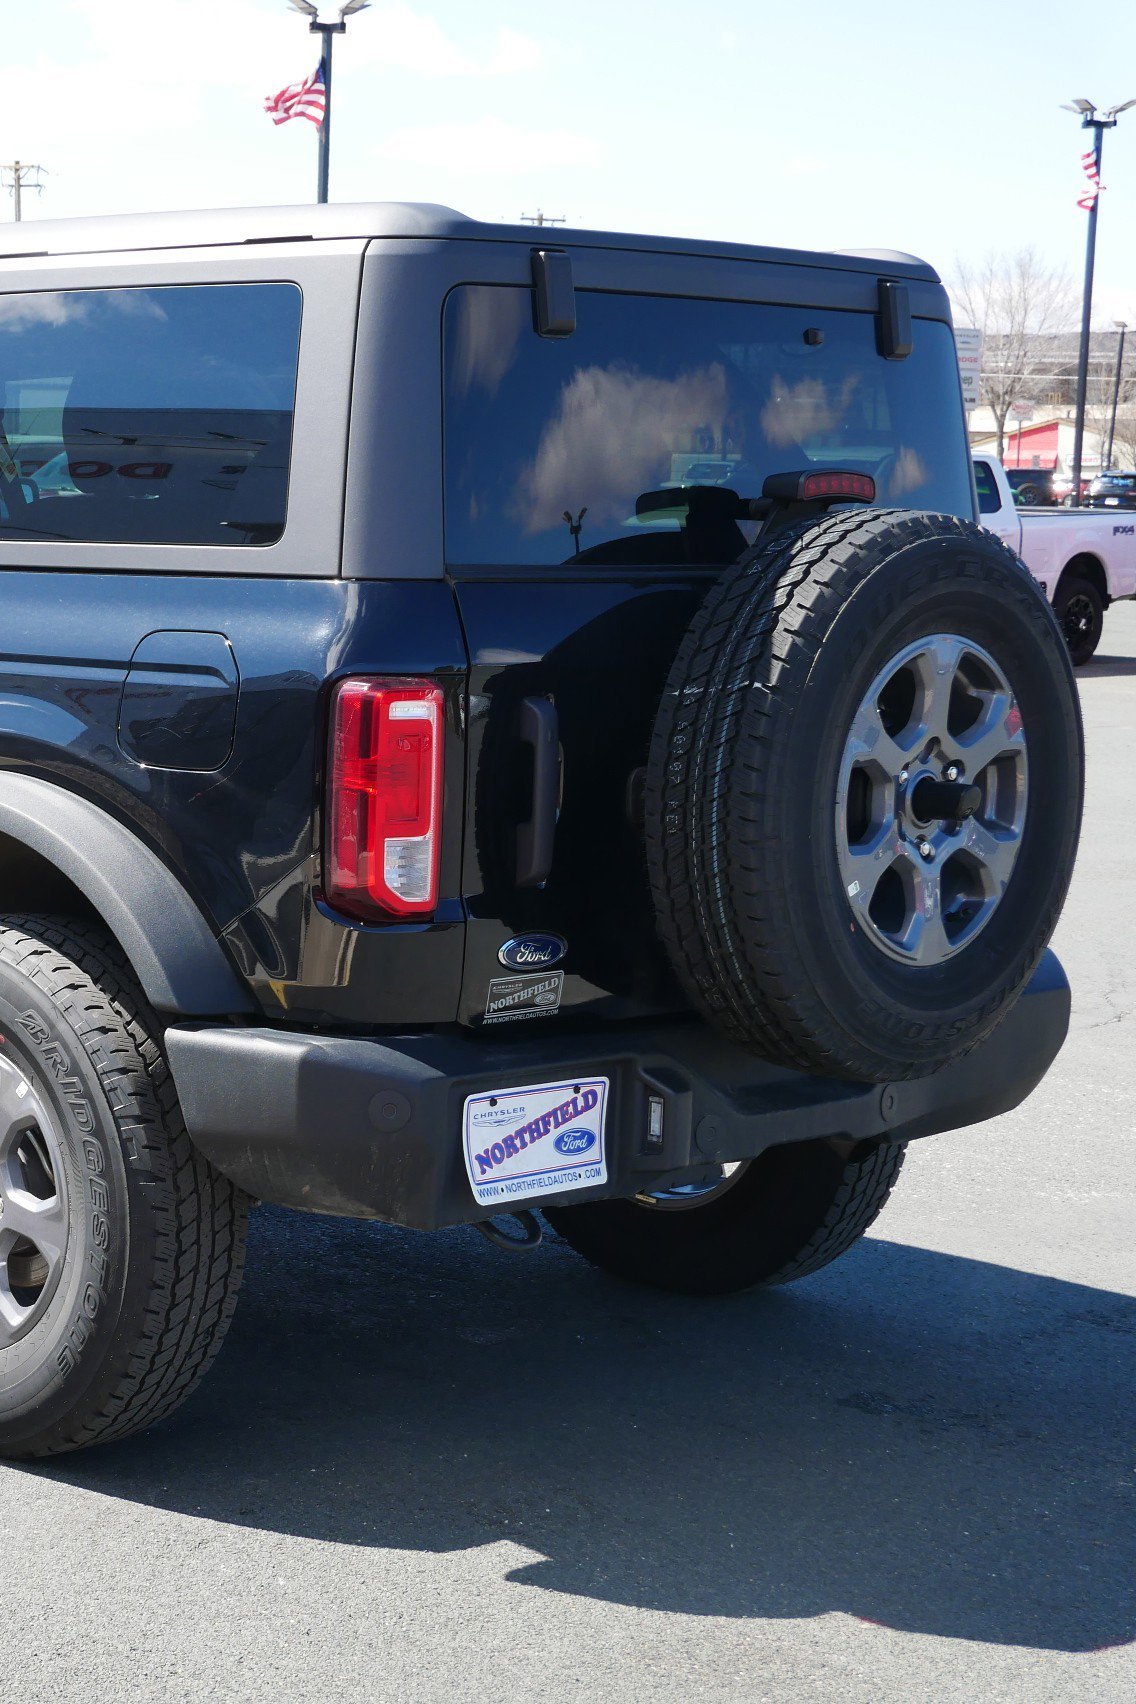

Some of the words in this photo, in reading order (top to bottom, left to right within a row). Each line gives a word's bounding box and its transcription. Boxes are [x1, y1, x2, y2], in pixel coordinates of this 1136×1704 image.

[1113, 525, 1135, 536] FX4
[516, 942, 552, 962] Ford
[489, 977, 559, 1012] NORTHFIELD
[473, 1107, 526, 1120] CHRYSLER
[475, 1088, 599, 1176] NORTHFIELD
[561, 1132, 588, 1152] Ford
[15, 1009, 111, 1378] BRIDGESTONE
